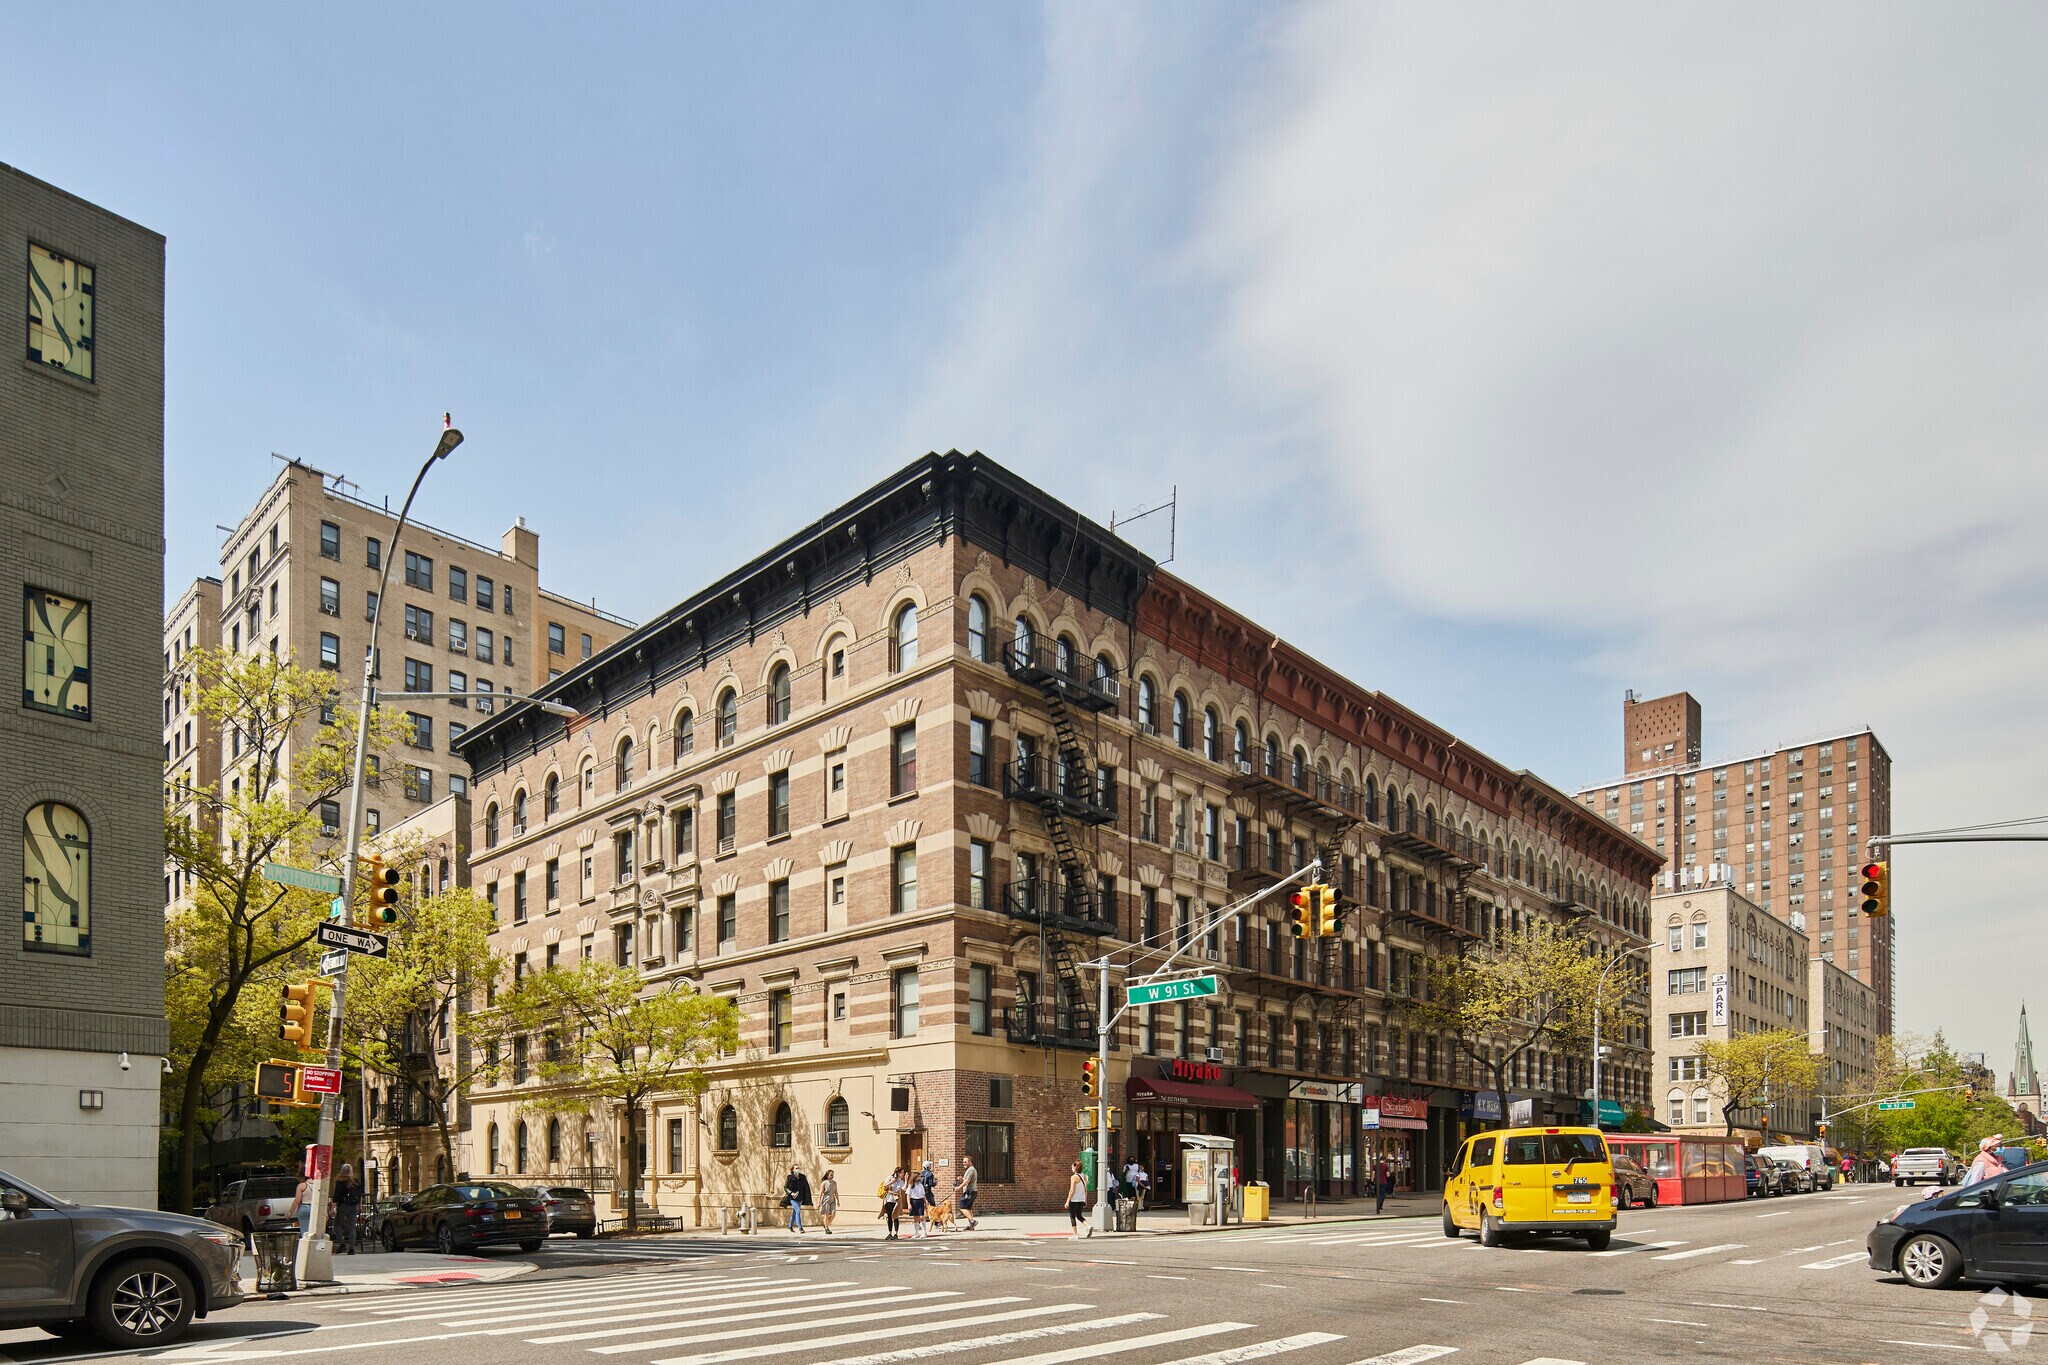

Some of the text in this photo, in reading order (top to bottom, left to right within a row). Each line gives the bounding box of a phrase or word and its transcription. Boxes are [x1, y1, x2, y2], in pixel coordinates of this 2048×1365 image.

[267, 863, 329, 890] AMSTERDAM
[328, 931, 378, 950] ONE WAY
[1148, 982, 1195, 1000] W 91 St
[1715, 987, 1724, 1017] PARK
[1171, 1058, 1221, 1080] Miyako
[283, 1072, 292, 1093] 5
[1385, 1099, 1413, 1112] Scarlatto
